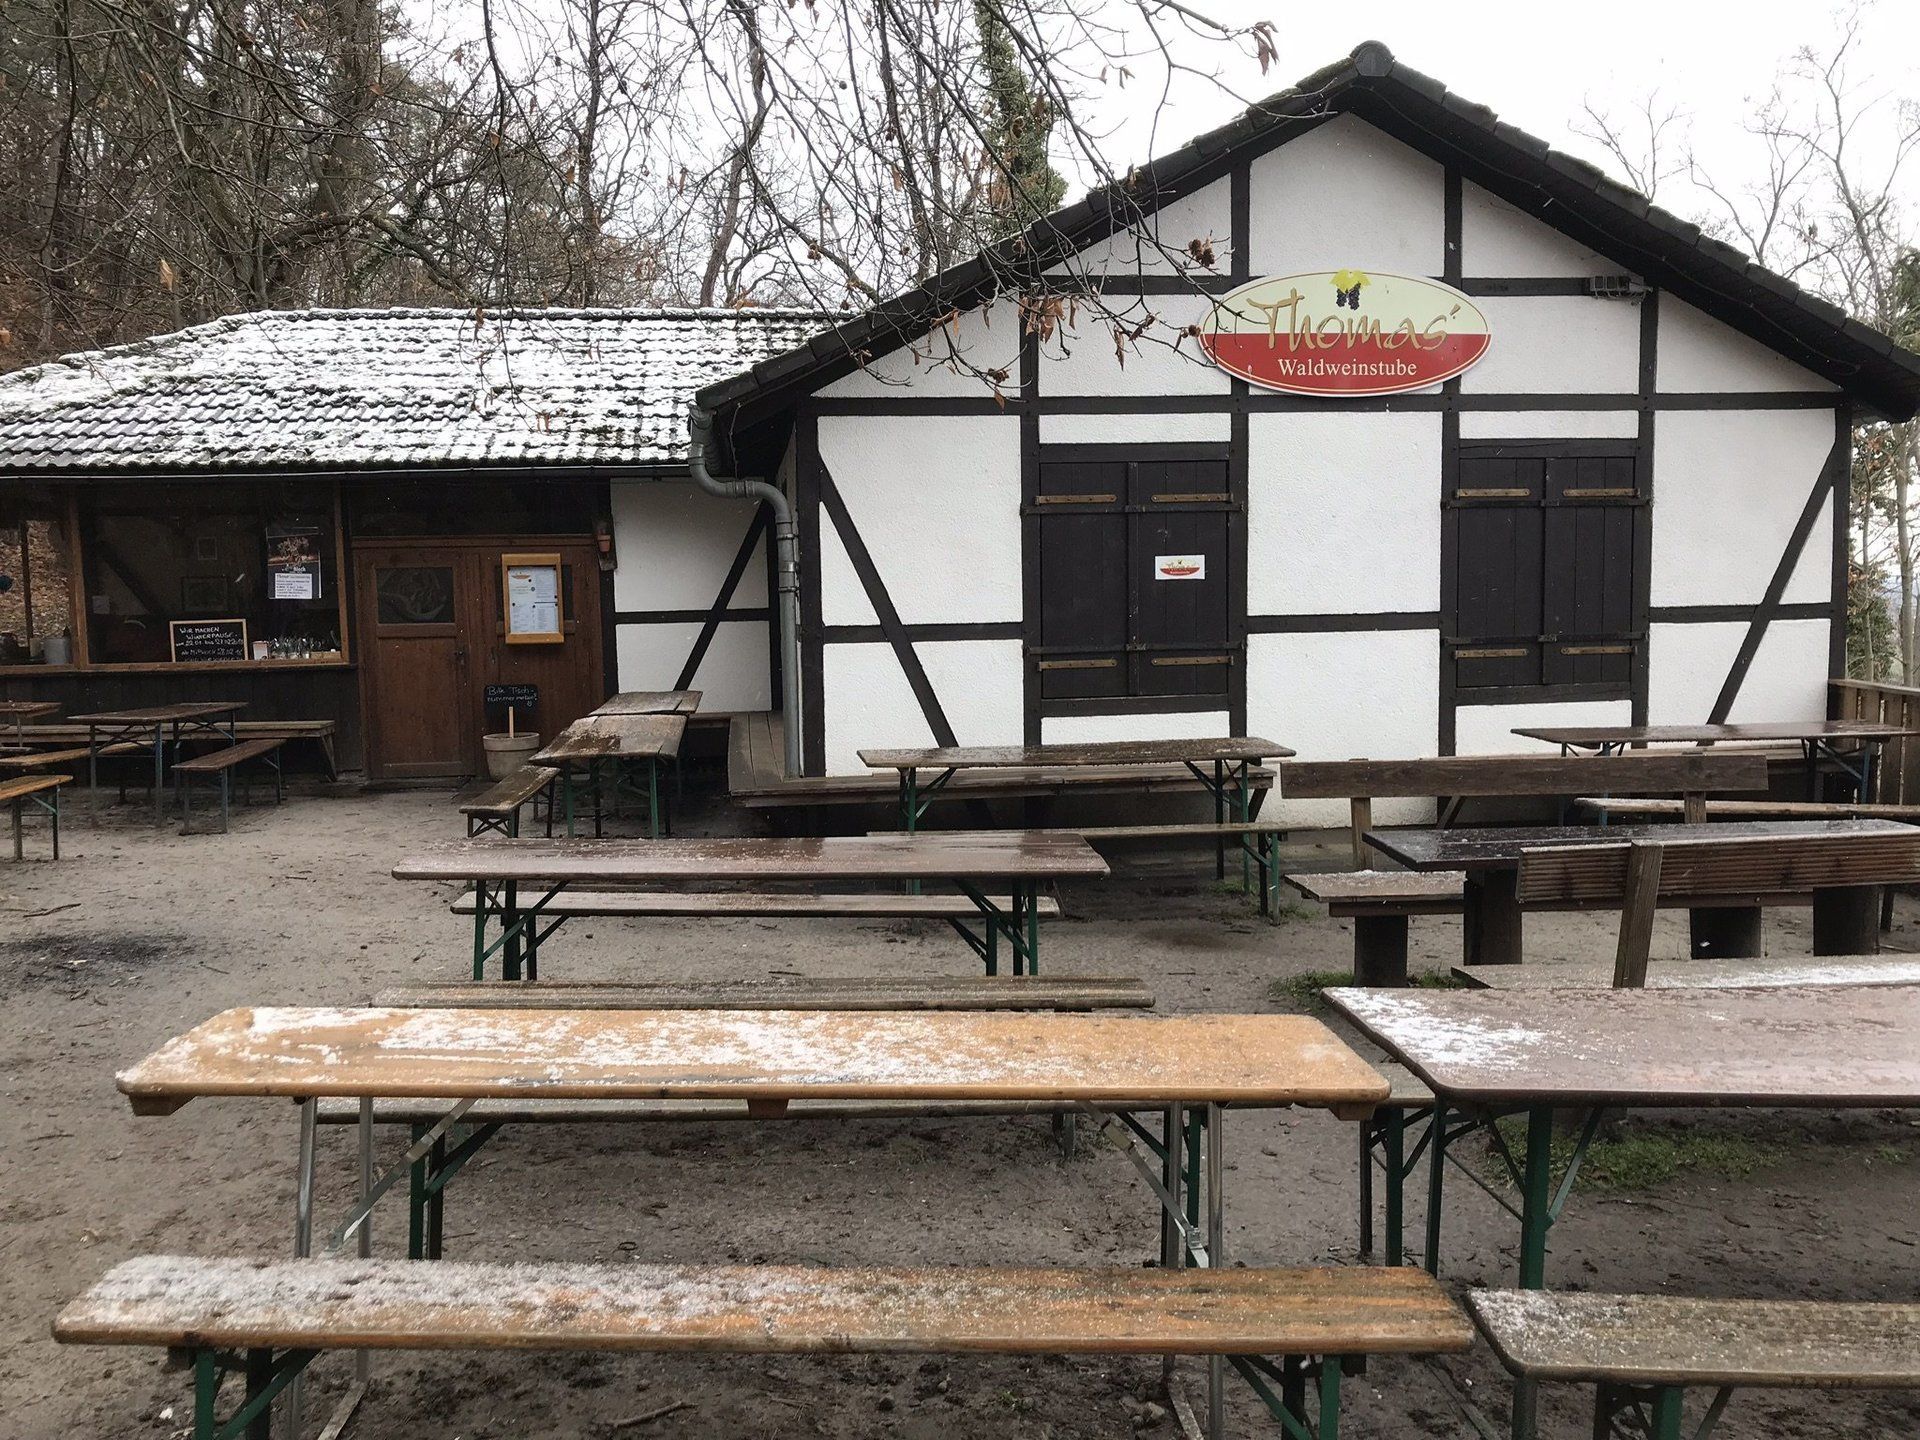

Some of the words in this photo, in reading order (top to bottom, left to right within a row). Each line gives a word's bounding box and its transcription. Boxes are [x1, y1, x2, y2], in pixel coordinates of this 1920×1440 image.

[1245, 287, 1461, 353] Thomas'
[1277, 358, 1417, 377] Waldweinstube
[194, 626, 220, 634] MACHEN
